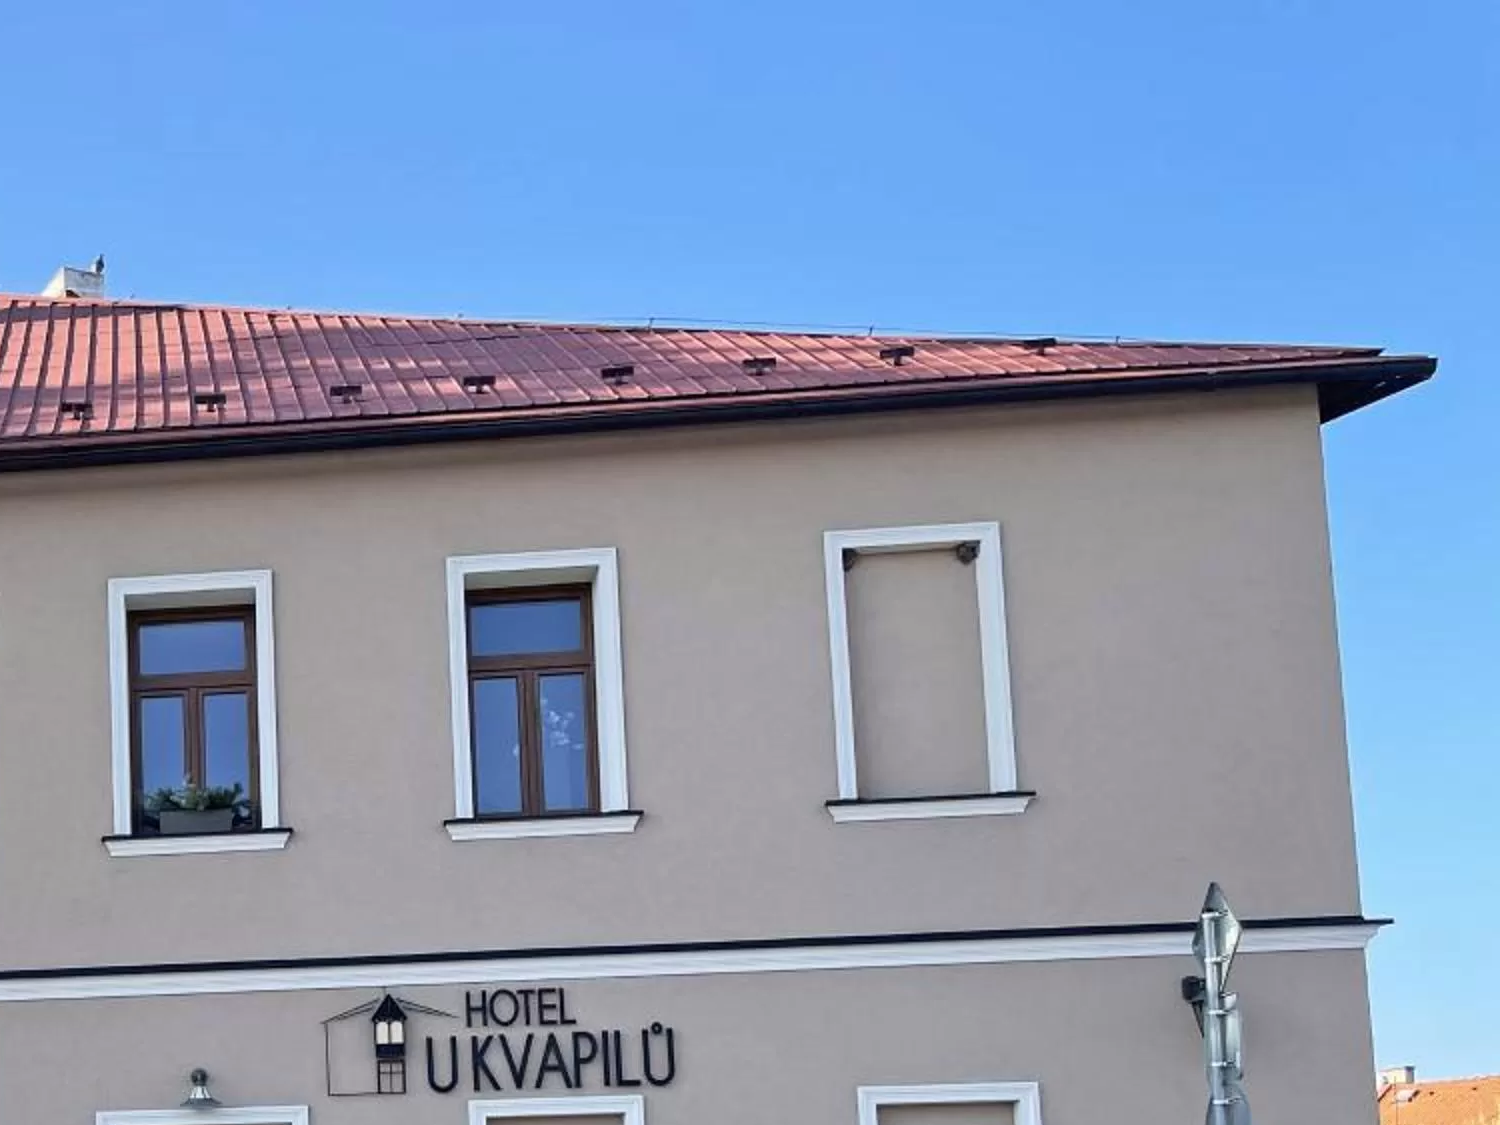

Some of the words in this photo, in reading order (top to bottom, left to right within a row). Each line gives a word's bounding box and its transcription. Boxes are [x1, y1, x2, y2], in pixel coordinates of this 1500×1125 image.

[465, 987, 577, 1028] HOTEL
[426, 1036, 459, 1093] U
[471, 1022, 676, 1092] KVAPILŮ
